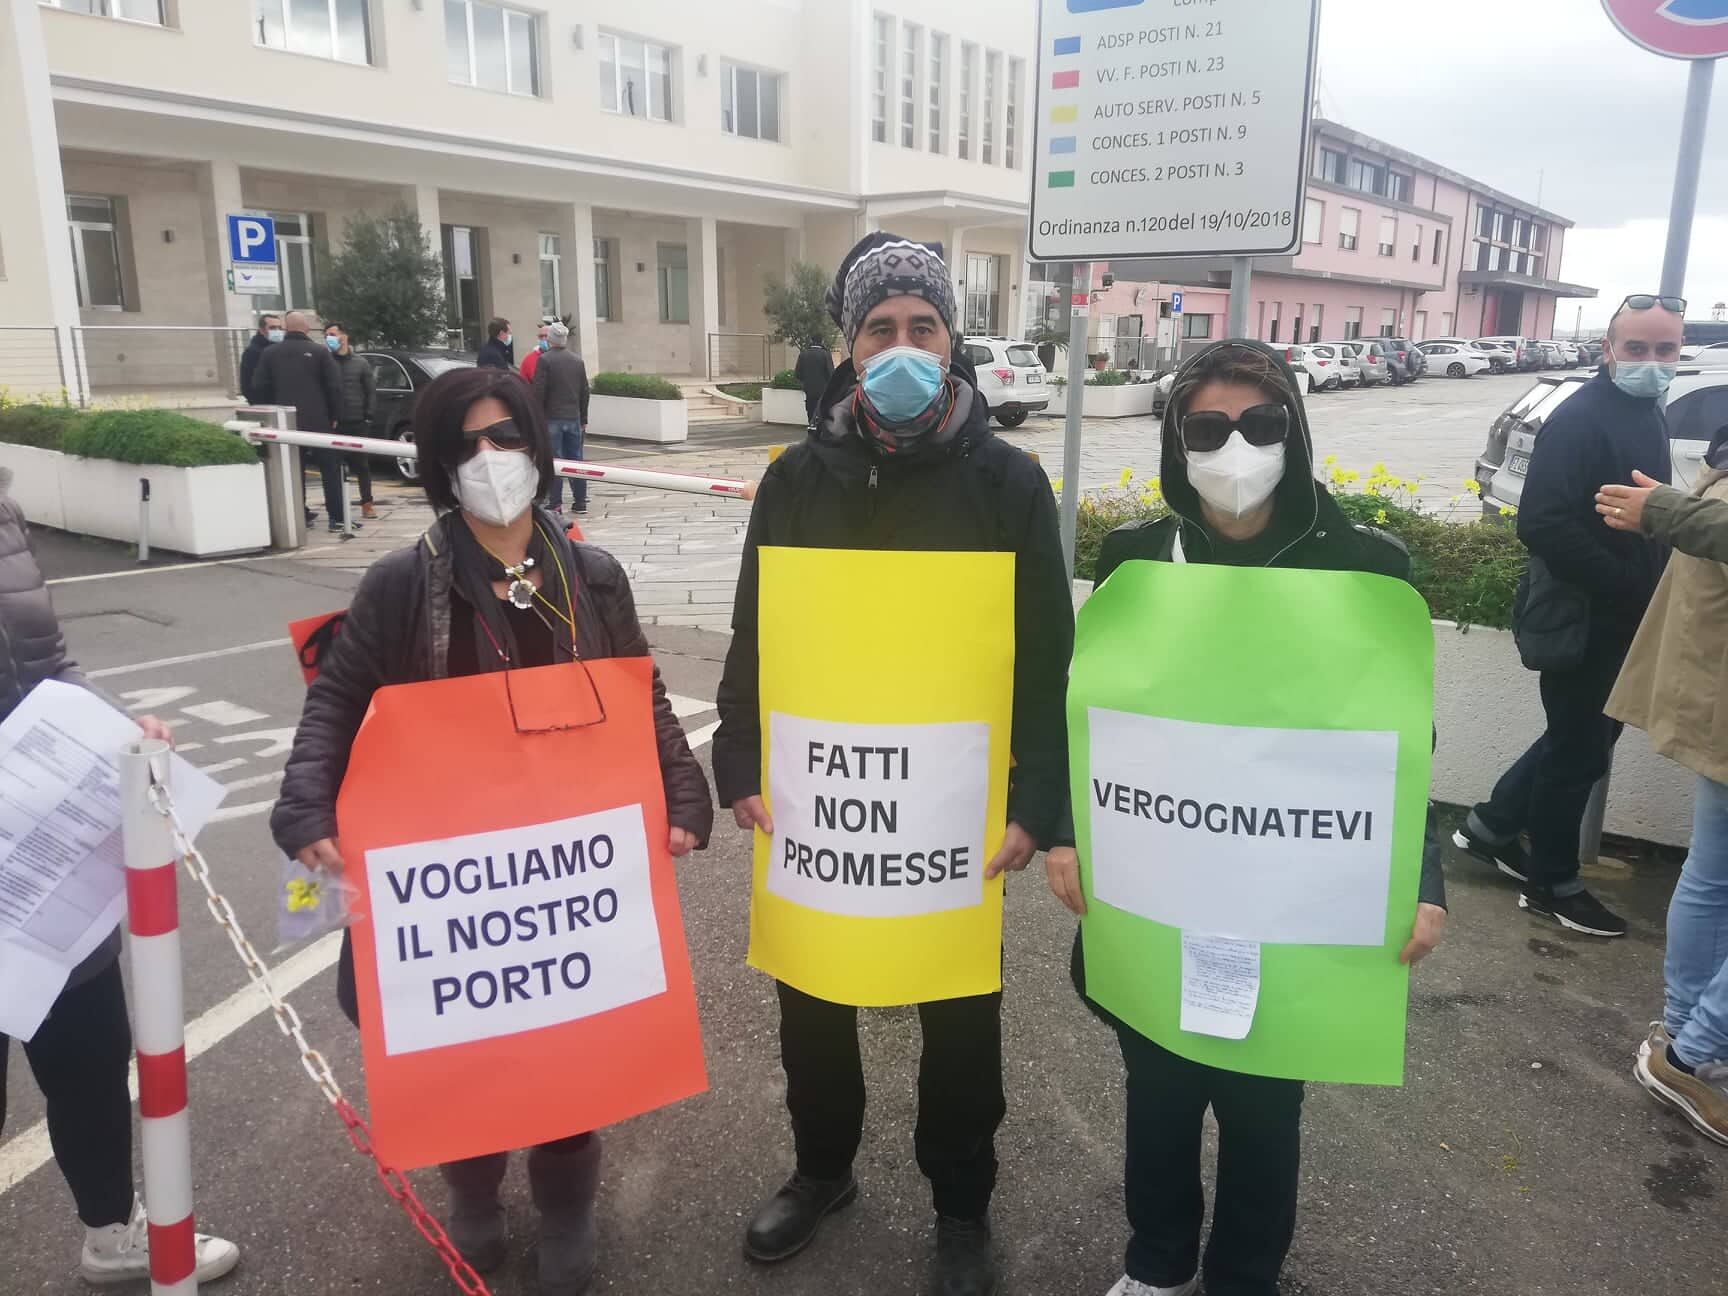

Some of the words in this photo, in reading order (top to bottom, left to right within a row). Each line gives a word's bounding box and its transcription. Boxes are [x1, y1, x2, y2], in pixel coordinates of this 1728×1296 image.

[1096, 32, 1135, 51] ADSP
[1138, 25, 1180, 45] POSTI
[1205, 20, 1223, 38] 21
[1139, 60, 1182, 80] POSTI
[1205, 55, 1225, 73] 23
[1093, 102, 1134, 120] AUTO
[1137, 98, 1178, 116] SERV.
[1183, 93, 1226, 112] POSTI
[1251, 90, 1261, 105] 5
[1092, 133, 1152, 151] CONCES.
[1157, 131, 1165, 146] 1
[1169, 127, 1212, 145] POSTI
[1237, 124, 1247, 140] 9
[1090, 167, 1150, 185] CONCES.
[1154, 166, 1163, 181] 2
[1167, 163, 1210, 181] POSTI
[1234, 160, 1244, 176] 3
[237, 219, 266, 258] P
[1039, 218, 1120, 237] Ordinanza
[1200, 208, 1292, 232] 19/10/2018
[1173, 295, 1181, 309] P
[809, 742, 908, 780] FATTI
[815, 796, 896, 833] NON
[1094, 779, 1372, 840] VERGOGNATEVI
[386, 833, 614, 905] VOGLIAMO
[784, 836, 969, 886] PROMESSE
[397, 925, 433, 961] IL
[448, 886, 618, 955] NOSTRO
[432, 951, 592, 1016] PORTO
